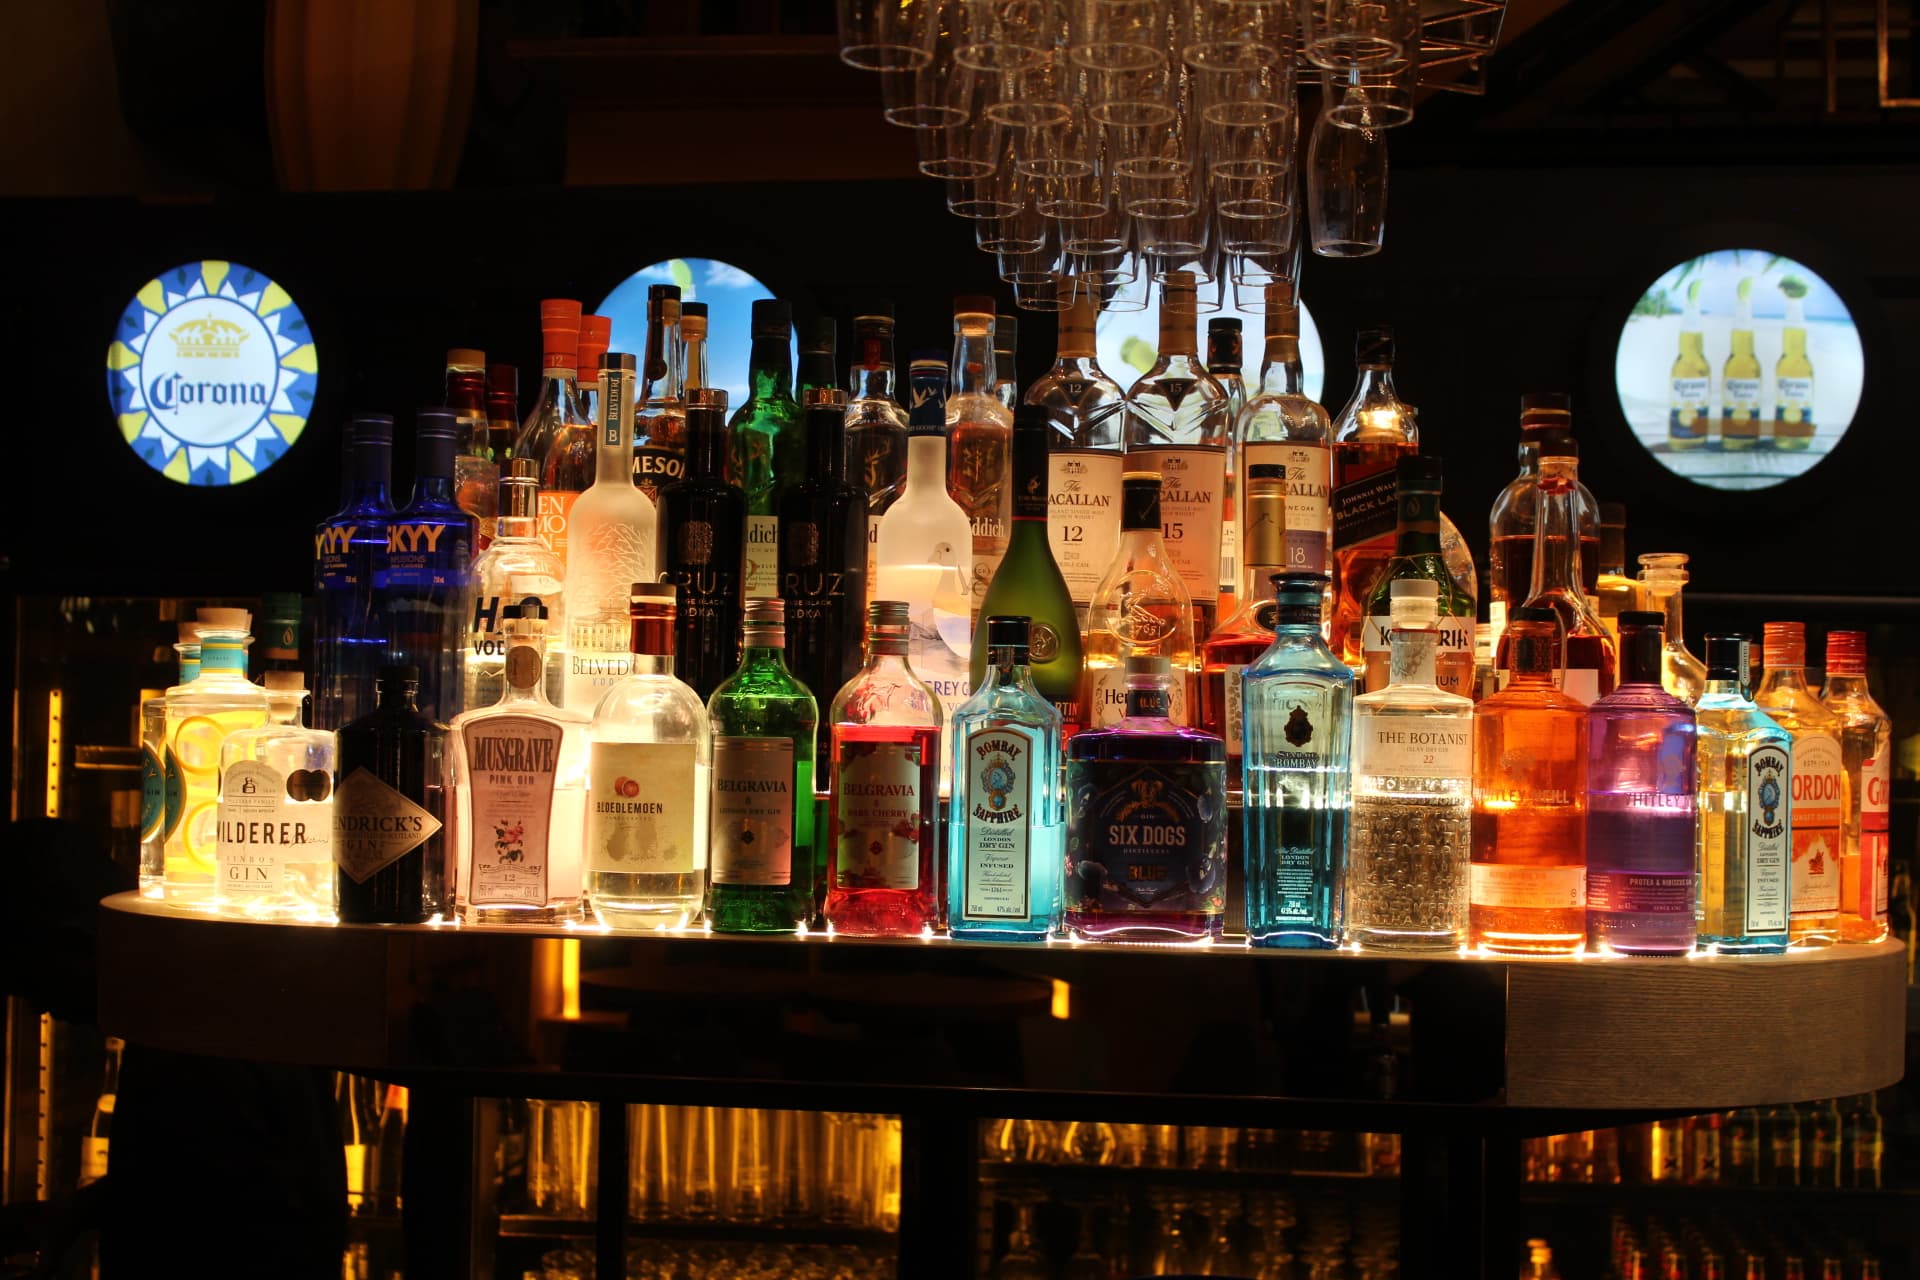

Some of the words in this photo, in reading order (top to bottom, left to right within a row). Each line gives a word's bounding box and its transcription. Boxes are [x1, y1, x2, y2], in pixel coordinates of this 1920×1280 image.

[149, 371, 267, 415] Corona
[1069, 383, 1082, 393] 12
[1169, 383, 1183, 393] 15
[632, 455, 685, 478] MESO
[1160, 490, 1212, 503] ALLAN
[1287, 483, 1329, 498] ALLAN
[538, 495, 566, 515] EN
[1048, 493, 1112, 507] ACALLAN
[1063, 525, 1083, 542] 12
[1163, 523, 1184, 539] 15
[1289, 547, 1306, 564] 18
[572, 655, 630, 676] BELVED
[932, 680, 960, 697] REY
[1377, 731, 1406, 744] THE
[1410, 732, 1468, 746] BOTANIST
[472, 736, 554, 773] MUSGRAVE
[975, 739, 1022, 761] BOMBAY
[1275, 758, 1318, 769] BOMBAY
[1423, 755, 1434, 764] 22
[1754, 755, 1784, 777] BOMBAY
[489, 774, 513, 785] PINK
[517, 775, 535, 785] GIN
[717, 778, 787, 793] BELGRAVIA
[1791, 774, 1841, 801] ORDON
[843, 783, 915, 797] BELGRAVIA
[596, 801, 663, 814] BLOEDLEMOEN
[972, 803, 1023, 824] SAPPHIRE
[332, 815, 423, 832] ENDRICK'S
[1752, 819, 1785, 839] SAPPHIRE
[216, 820, 307, 845] ILDERER
[1109, 825, 1139, 845] SIX
[1142, 825, 1186, 847] DOGS
[229, 866, 268, 881] GIN
